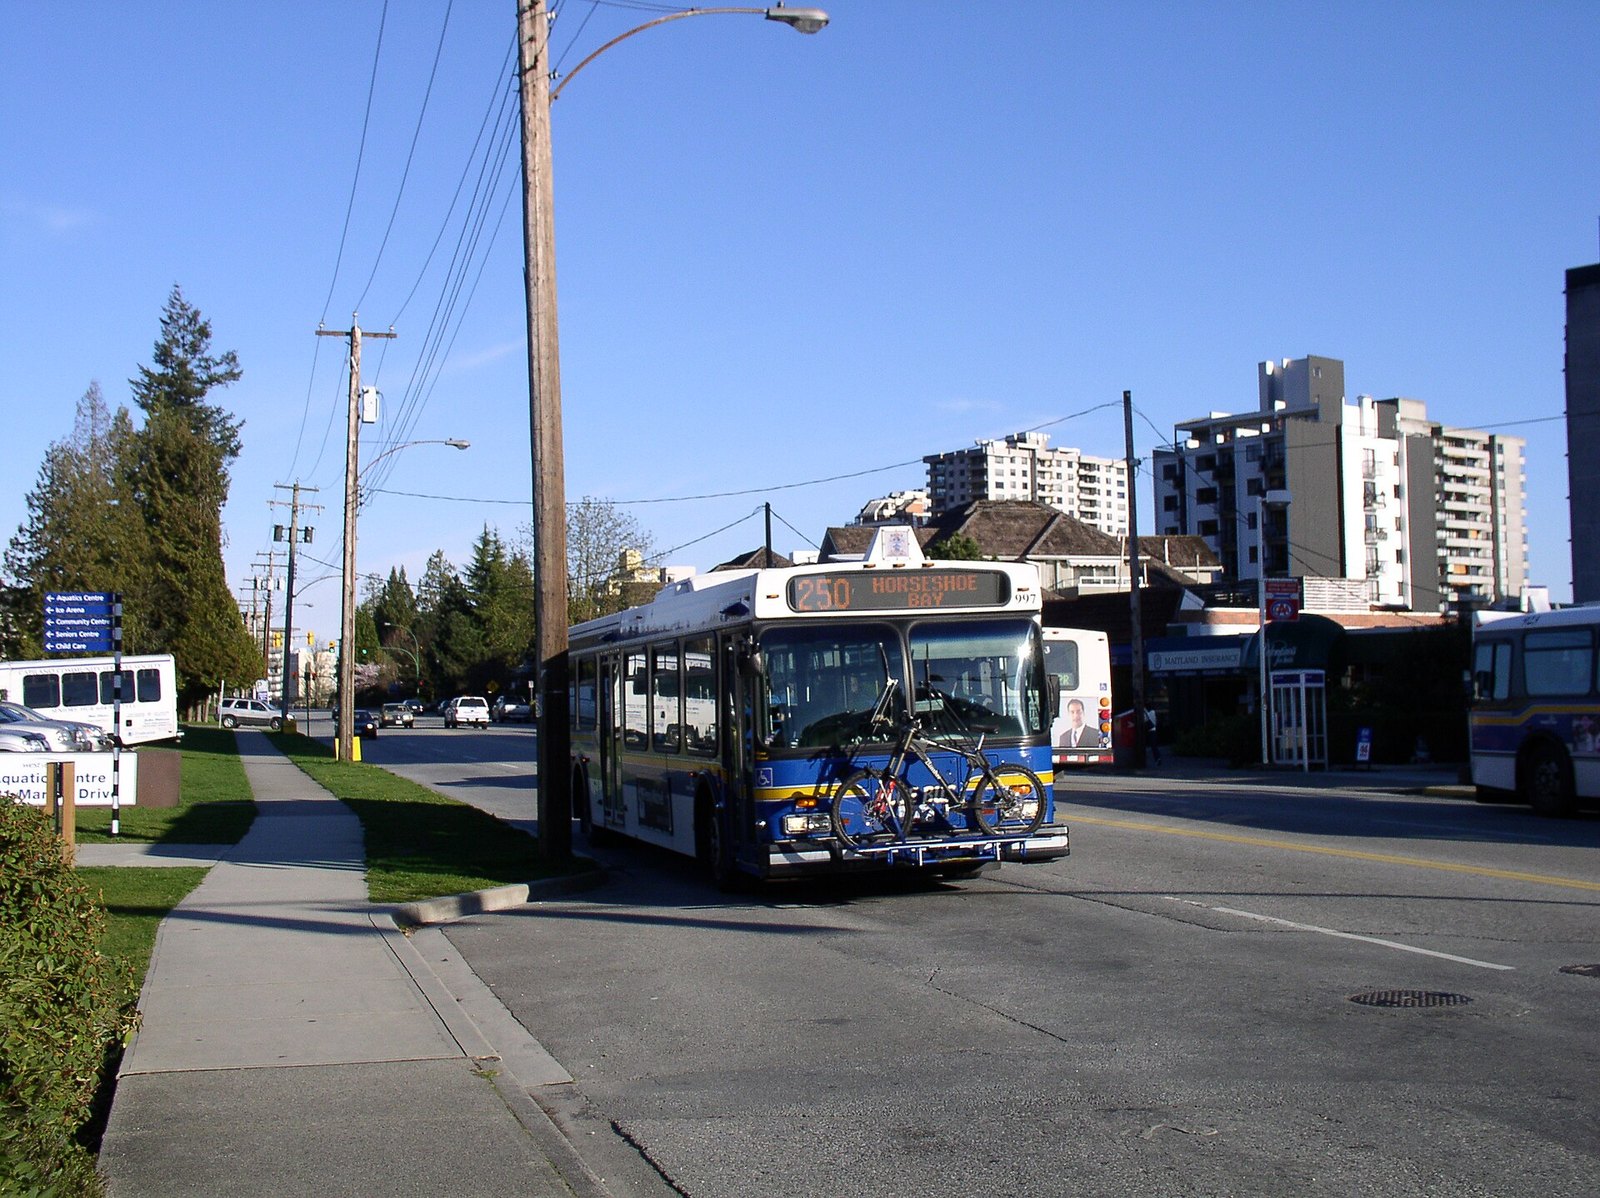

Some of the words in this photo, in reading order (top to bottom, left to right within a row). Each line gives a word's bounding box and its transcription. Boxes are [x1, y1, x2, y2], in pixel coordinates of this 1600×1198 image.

[798, 578, 850, 611] 250
[872, 574, 977, 594] HORSESHOE
[56, 594, 83, 603] Aquatics
[83, 594, 105, 602] Centre
[907, 591, 945, 608] BAY
[1015, 593, 1037, 605] 997
[55, 618, 90, 626] Community
[1200, 653, 1239, 664] INSURANCE
[0, 772, 48, 785] quatic
[76, 772, 107, 783] ntre
[19, 789, 47, 800] Mar
